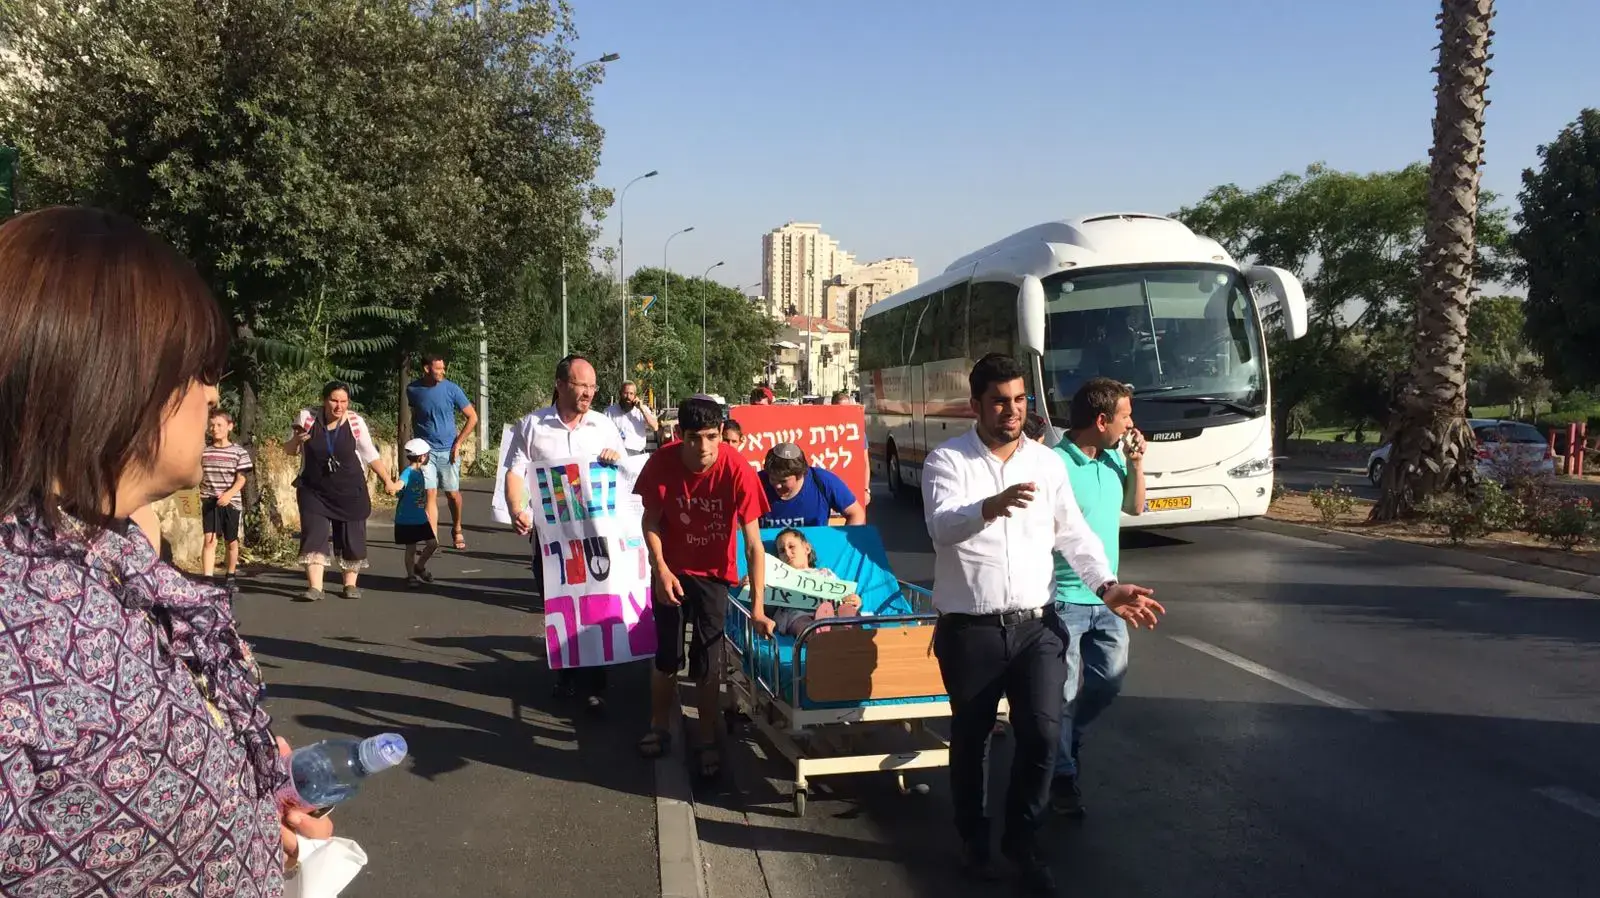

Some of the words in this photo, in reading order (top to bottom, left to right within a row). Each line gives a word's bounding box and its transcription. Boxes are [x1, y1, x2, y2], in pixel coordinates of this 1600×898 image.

[809, 423, 860, 445] בירת
[1153, 432, 1181, 441] IRIZAR
[810, 446, 853, 470] ללא
[774, 563, 789, 580] לי
[797, 574, 847, 595] פתחו
